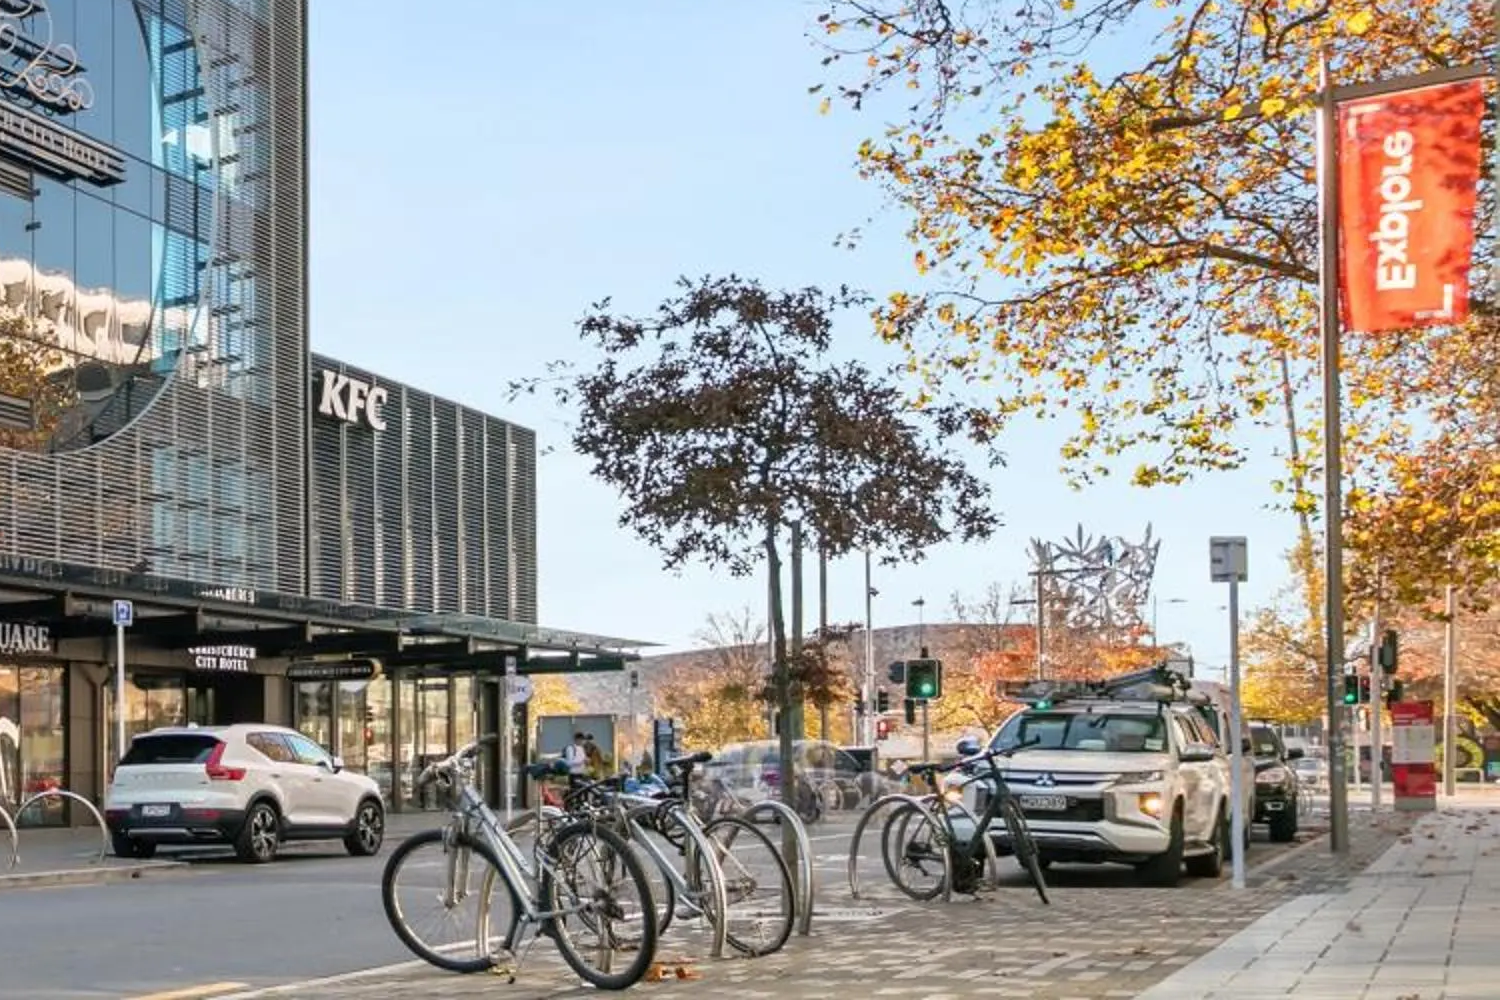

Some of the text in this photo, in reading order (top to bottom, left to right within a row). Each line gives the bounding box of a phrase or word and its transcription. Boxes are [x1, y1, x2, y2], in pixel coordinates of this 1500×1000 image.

[319, 369, 388, 431] KFC
[195, 655, 248, 672] CITY HOTEL
